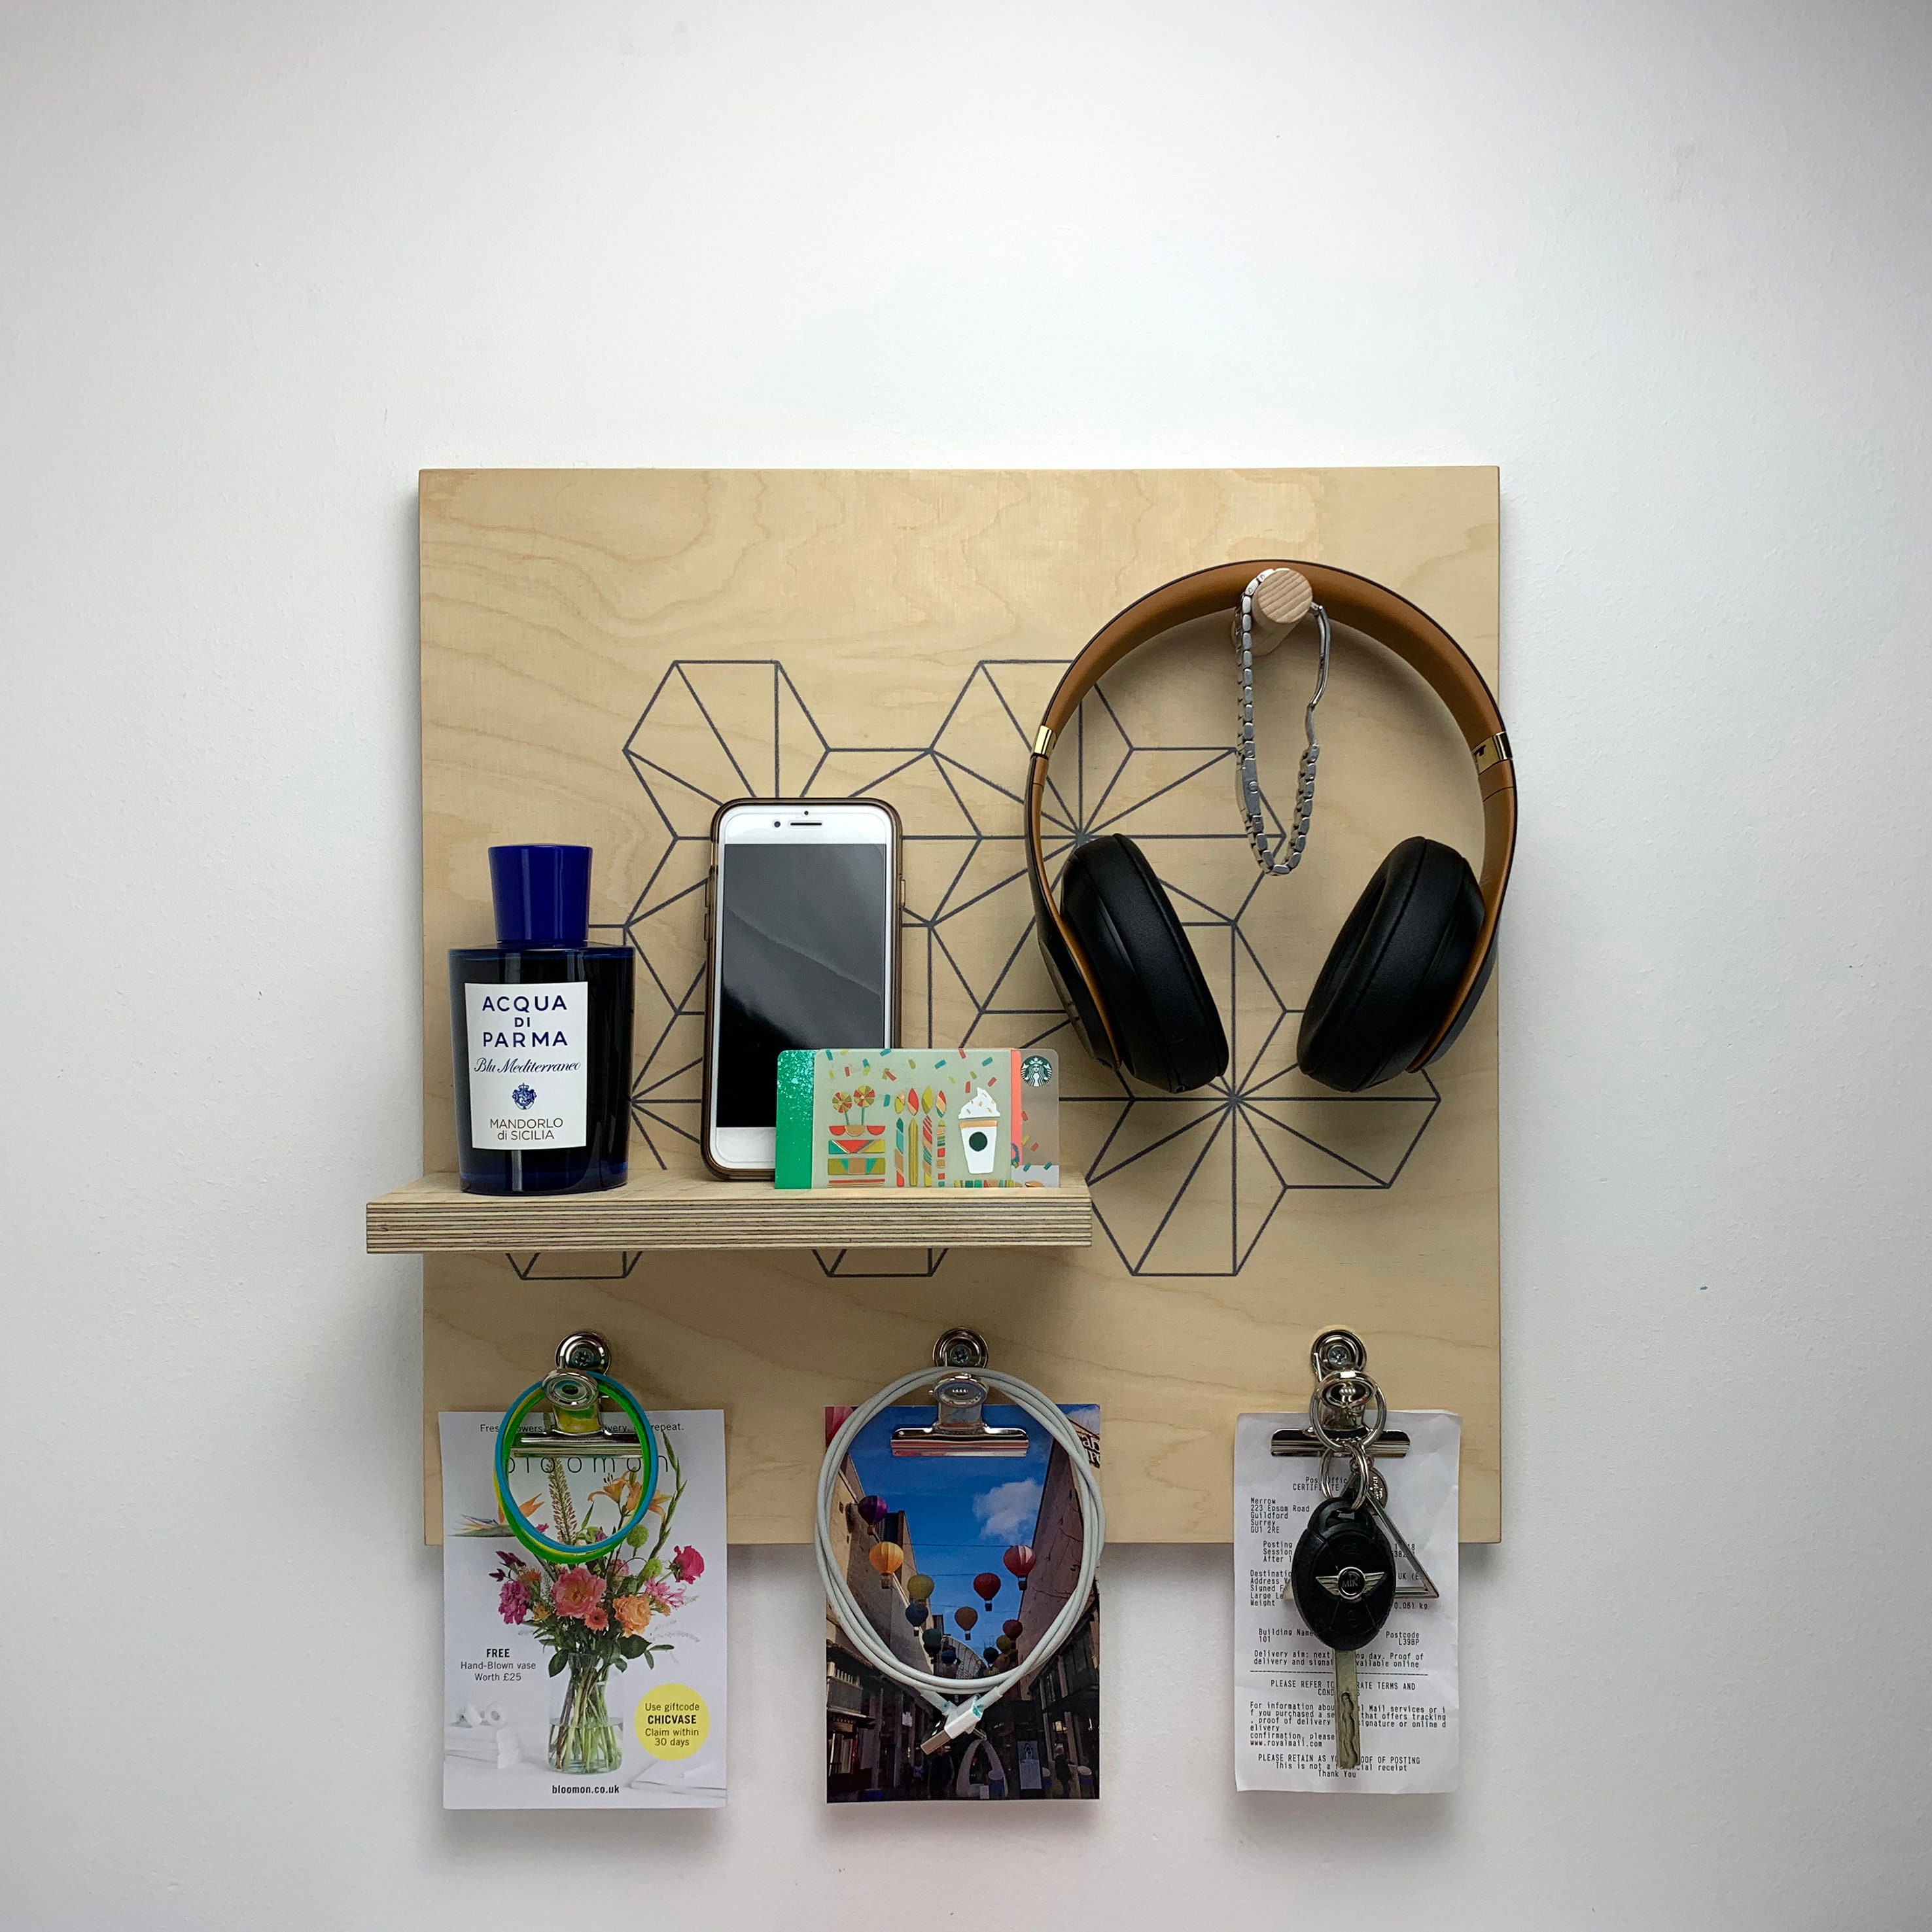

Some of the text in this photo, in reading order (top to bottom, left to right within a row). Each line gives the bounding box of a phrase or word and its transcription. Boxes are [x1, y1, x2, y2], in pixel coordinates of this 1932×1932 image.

[482, 995, 568, 1013] ACQUA
[514, 1017, 531, 1028] DI
[483, 1031, 568, 1047] PARMA
[474, 1057, 581, 1073] Blu Mediterraneo
[490, 1117, 563, 1129] MANDORLO
[497, 1129, 555, 1140] di SICILIA
[480, 1424, 499, 1432] Fres
[1263, 1540, 1293, 1549] Posting
[1250, 1584, 1276, 1592] Signed
[1258, 1628, 1293, 1636] Building
[1385, 1630, 1420, 1639] Postcode
[486, 1648, 510, 1658] FREE
[1254, 1649, 1288, 1658] Delivery
[1390, 1652, 1411, 1660] Proof
[460, 1661, 514, 1670] Hand-Blown
[1254, 1657, 1288, 1666] delivery
[1356, 1659, 1420, 1668] vailable online
[474, 1672, 521, 1681] Worth £25
[1270, 1679, 1297, 1688] PLEASE
[1301, 1680, 1322, 1689] REFER
[1377, 1682, 1398, 1691] TERMS
[644, 1702, 700, 1713] Use giftcode
[1267, 1702, 1314, 1710] information
[1390, 1705, 1424, 1713] services
[647, 1714, 697, 1725] CHICVASE
[1297, 1717, 1331, 1726] delivery
[1250, 1723, 1280, 1732] elivery
[1412, 1720, 1438, 1729] online
[644, 1728, 699, 1736] Claim within
[1250, 1731, 1335, 1741] confirmation, please
[654, 1737, 690, 1748] 30 days
[1250, 1739, 1323, 1748] www.royalmail.com
[1258, 1753, 1284, 1762] PLEASE
[1288, 1754, 1314, 1763] RETAIN
[1390, 1756, 1420, 1765] POSTING
[1276, 1761, 1293, 1770] This
[1343, 1770, 1356, 1778] You
[552, 1784, 620, 1794] bloomon.co.uk
